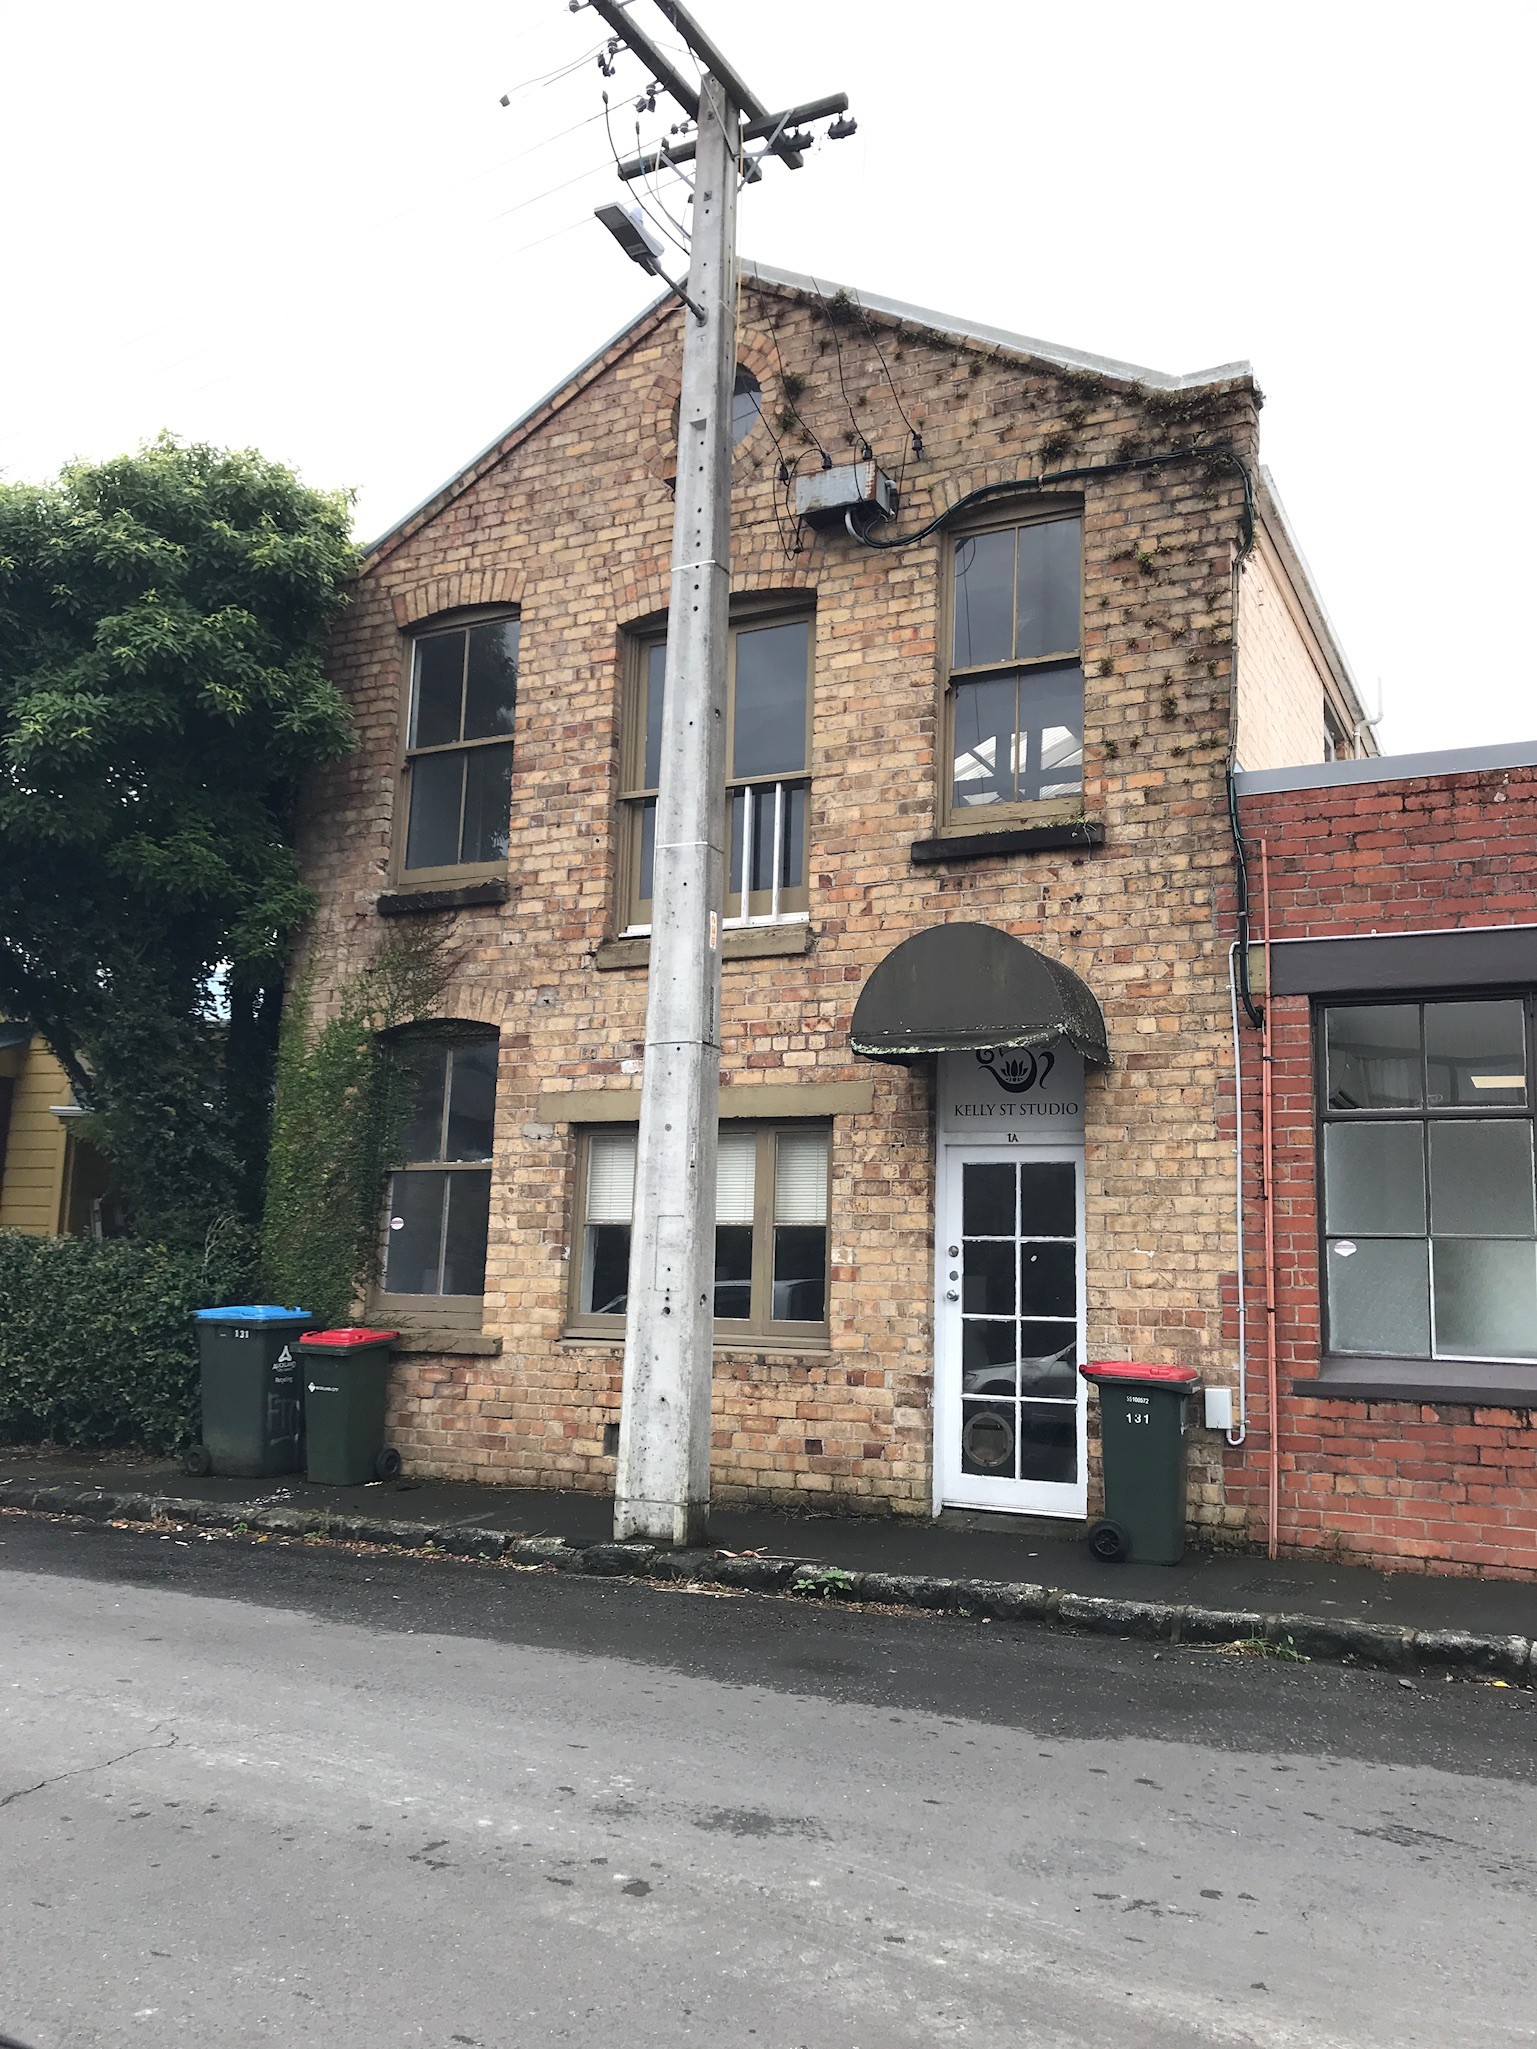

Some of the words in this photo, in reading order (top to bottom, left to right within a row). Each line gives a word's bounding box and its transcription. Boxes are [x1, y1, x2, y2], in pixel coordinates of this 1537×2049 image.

[954, 1104, 996, 1116] KELLY
[1000, 1103, 1016, 1116] ST
[1019, 1102, 1079, 1116] STUDIO
[1007, 1132, 1019, 1143] 1A
[234, 1329, 249, 1339] 131
[1125, 1412, 1149, 1425] 131
